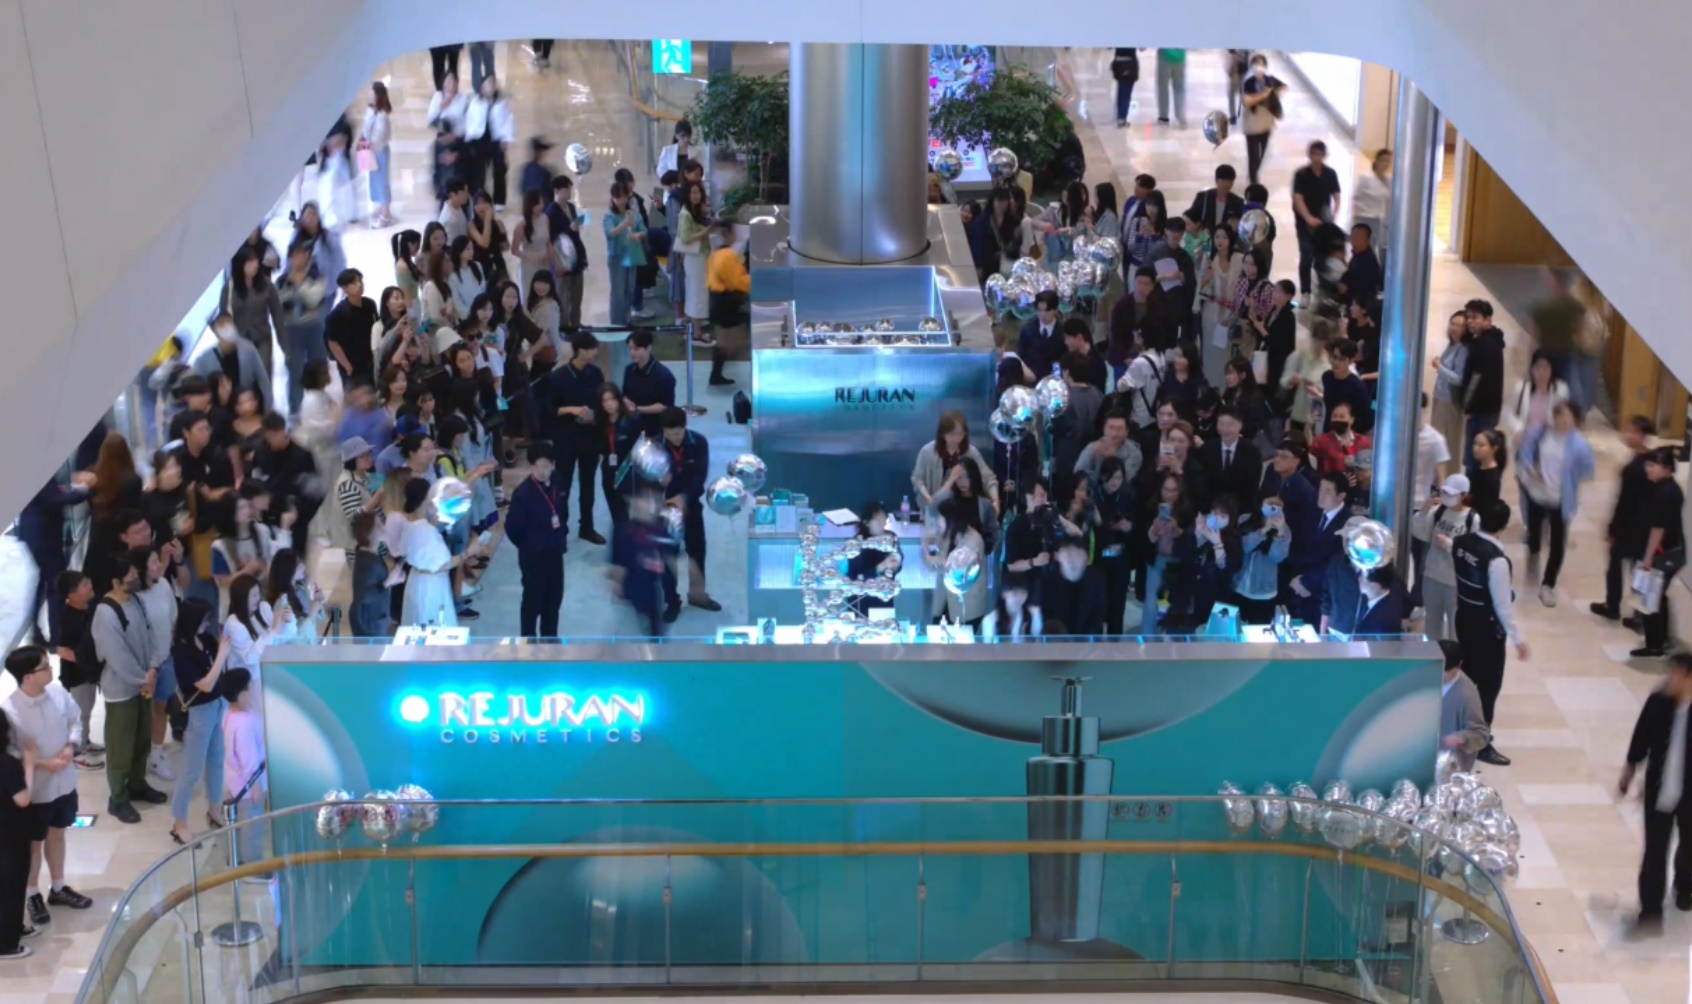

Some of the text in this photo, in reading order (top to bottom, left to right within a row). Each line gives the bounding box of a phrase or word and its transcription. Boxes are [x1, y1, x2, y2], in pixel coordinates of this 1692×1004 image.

[835, 387, 915, 403] REJURAN
[438, 692, 645, 726] REJURAN
[440, 729, 643, 744] COSMETICS
